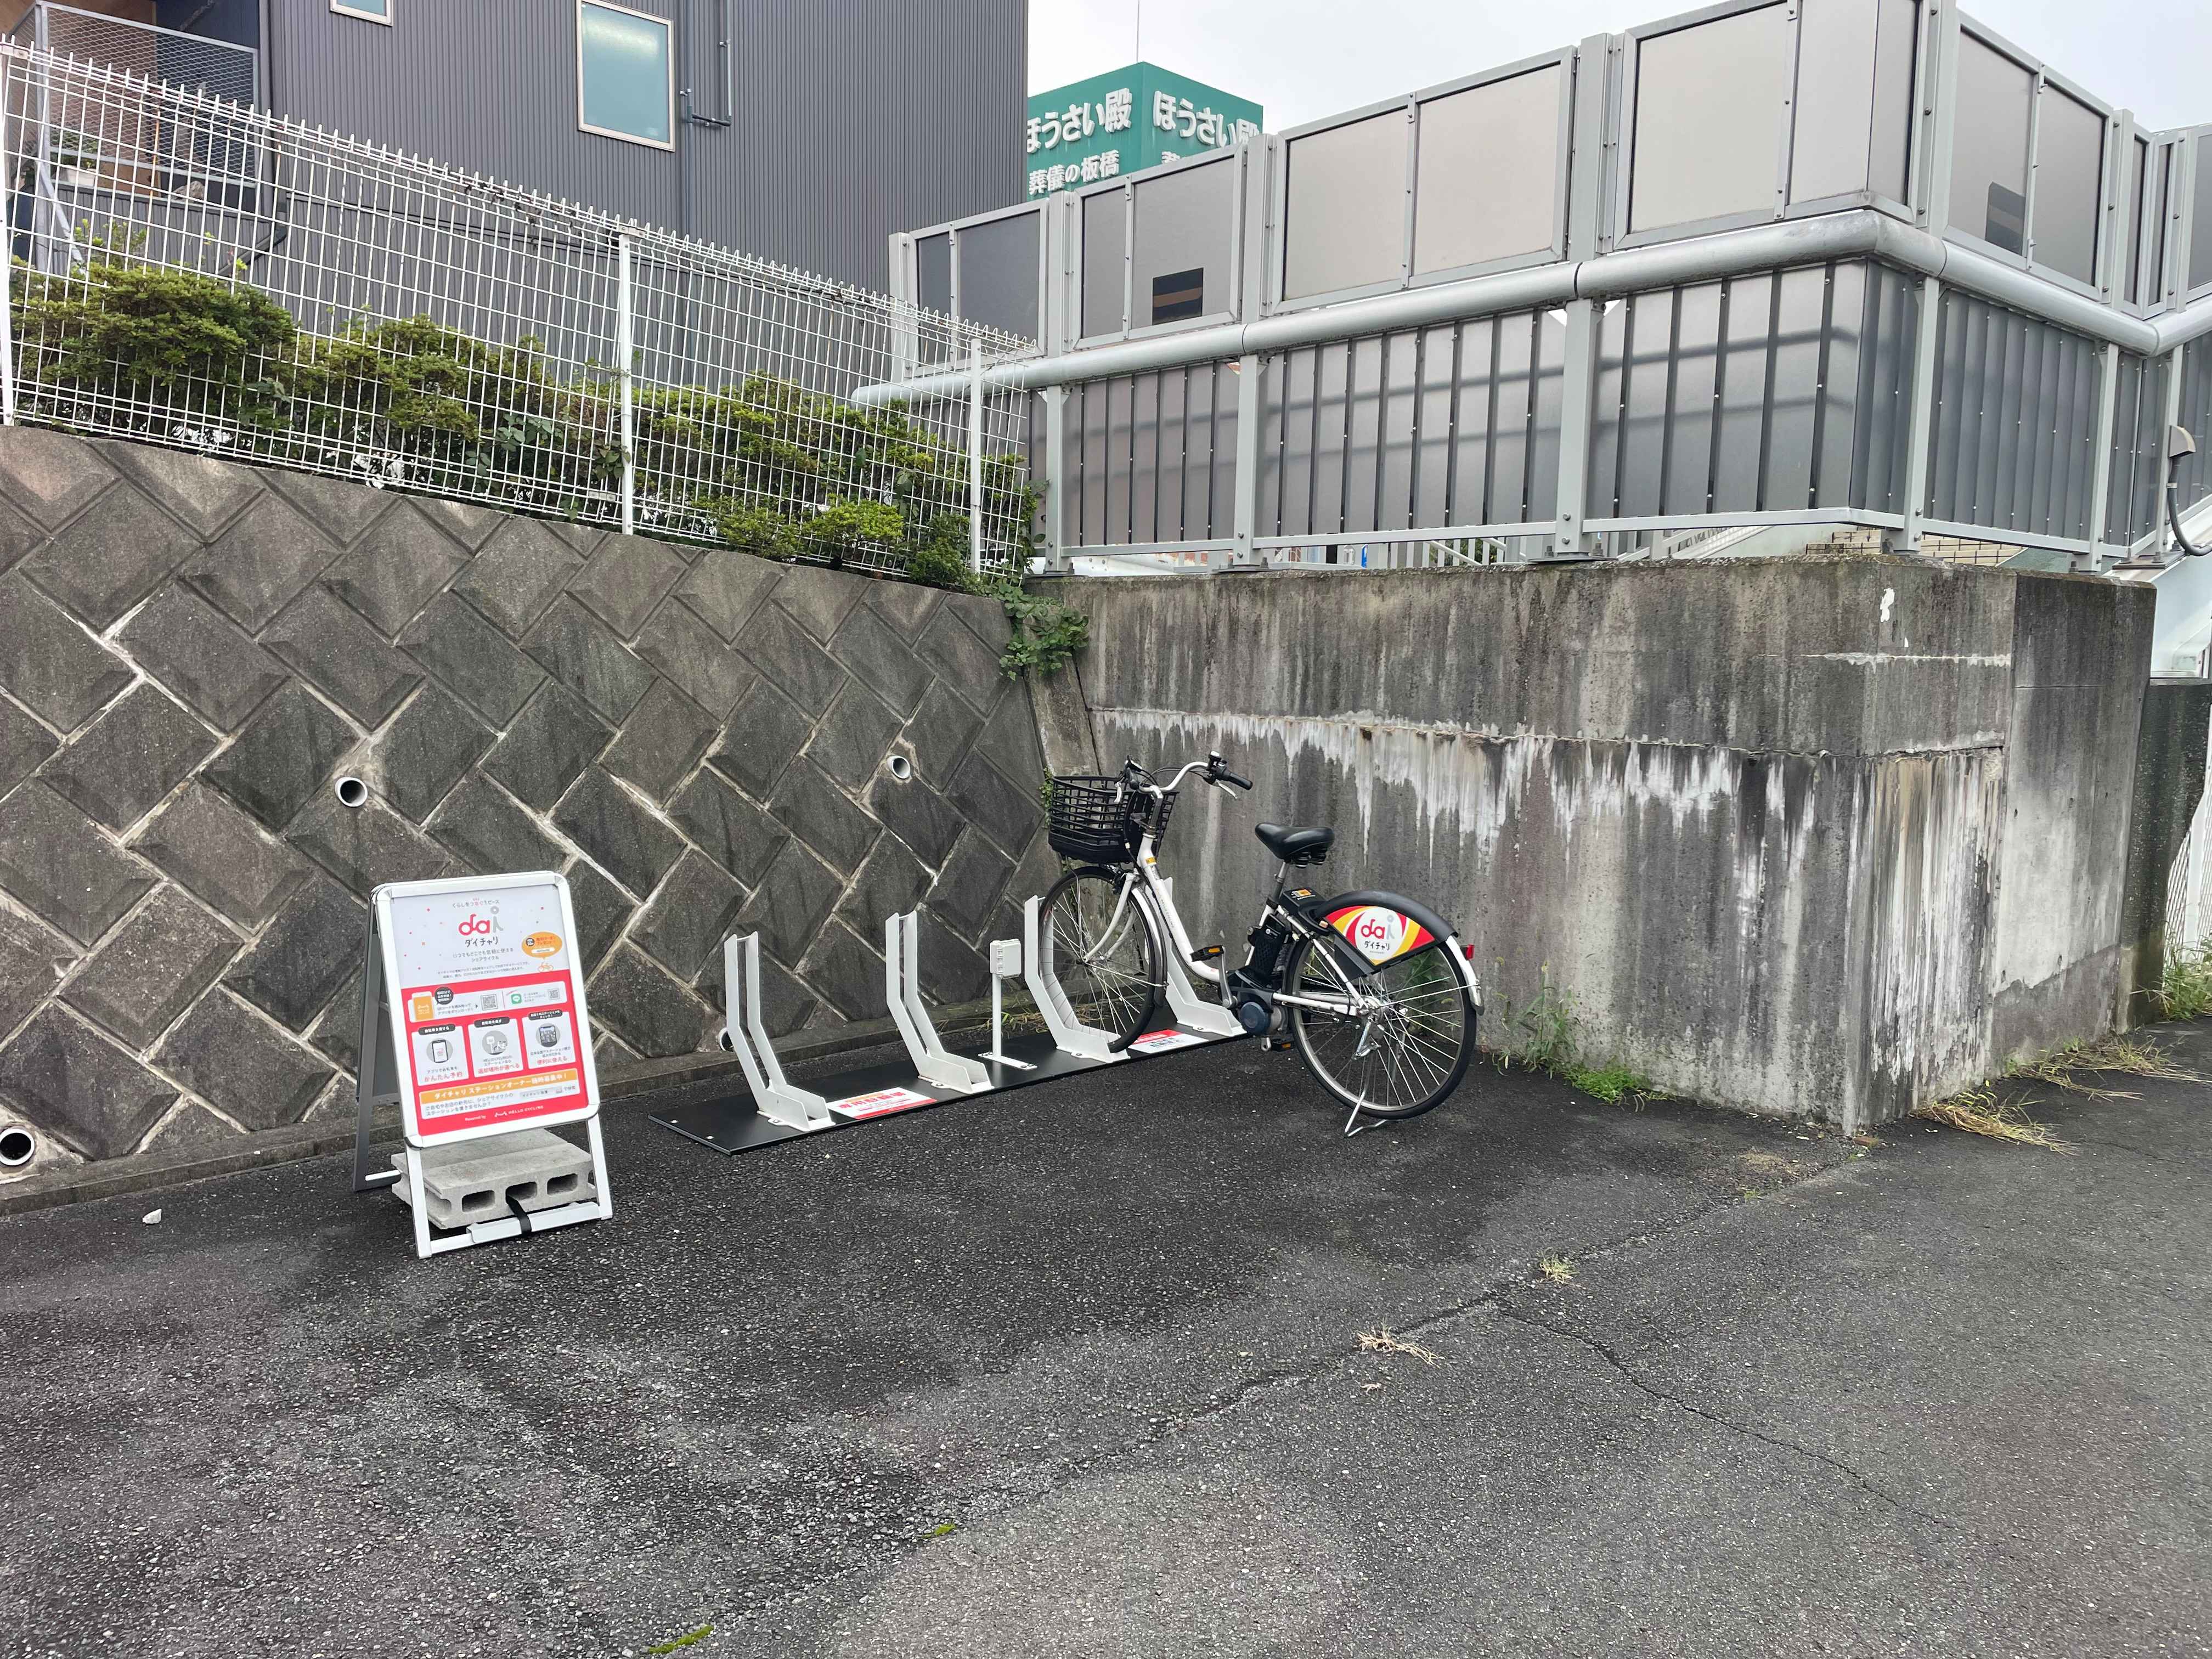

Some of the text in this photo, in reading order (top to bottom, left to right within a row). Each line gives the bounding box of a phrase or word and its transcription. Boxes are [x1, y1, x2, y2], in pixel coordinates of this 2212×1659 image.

[1026, 88, 1133, 153] ほうさい殿
[1029, 149, 1120, 196] 葬儀の板橋
[458, 905, 504, 936] dai
[1361, 915, 1395, 940] dai
[465, 936, 499, 947] ダイチャリ
[1364, 940, 1390, 951] ダイチャリ
[424, 1071, 463, 1082] かんたん予約
[435, 1088, 466, 1100] ダイチャリ
